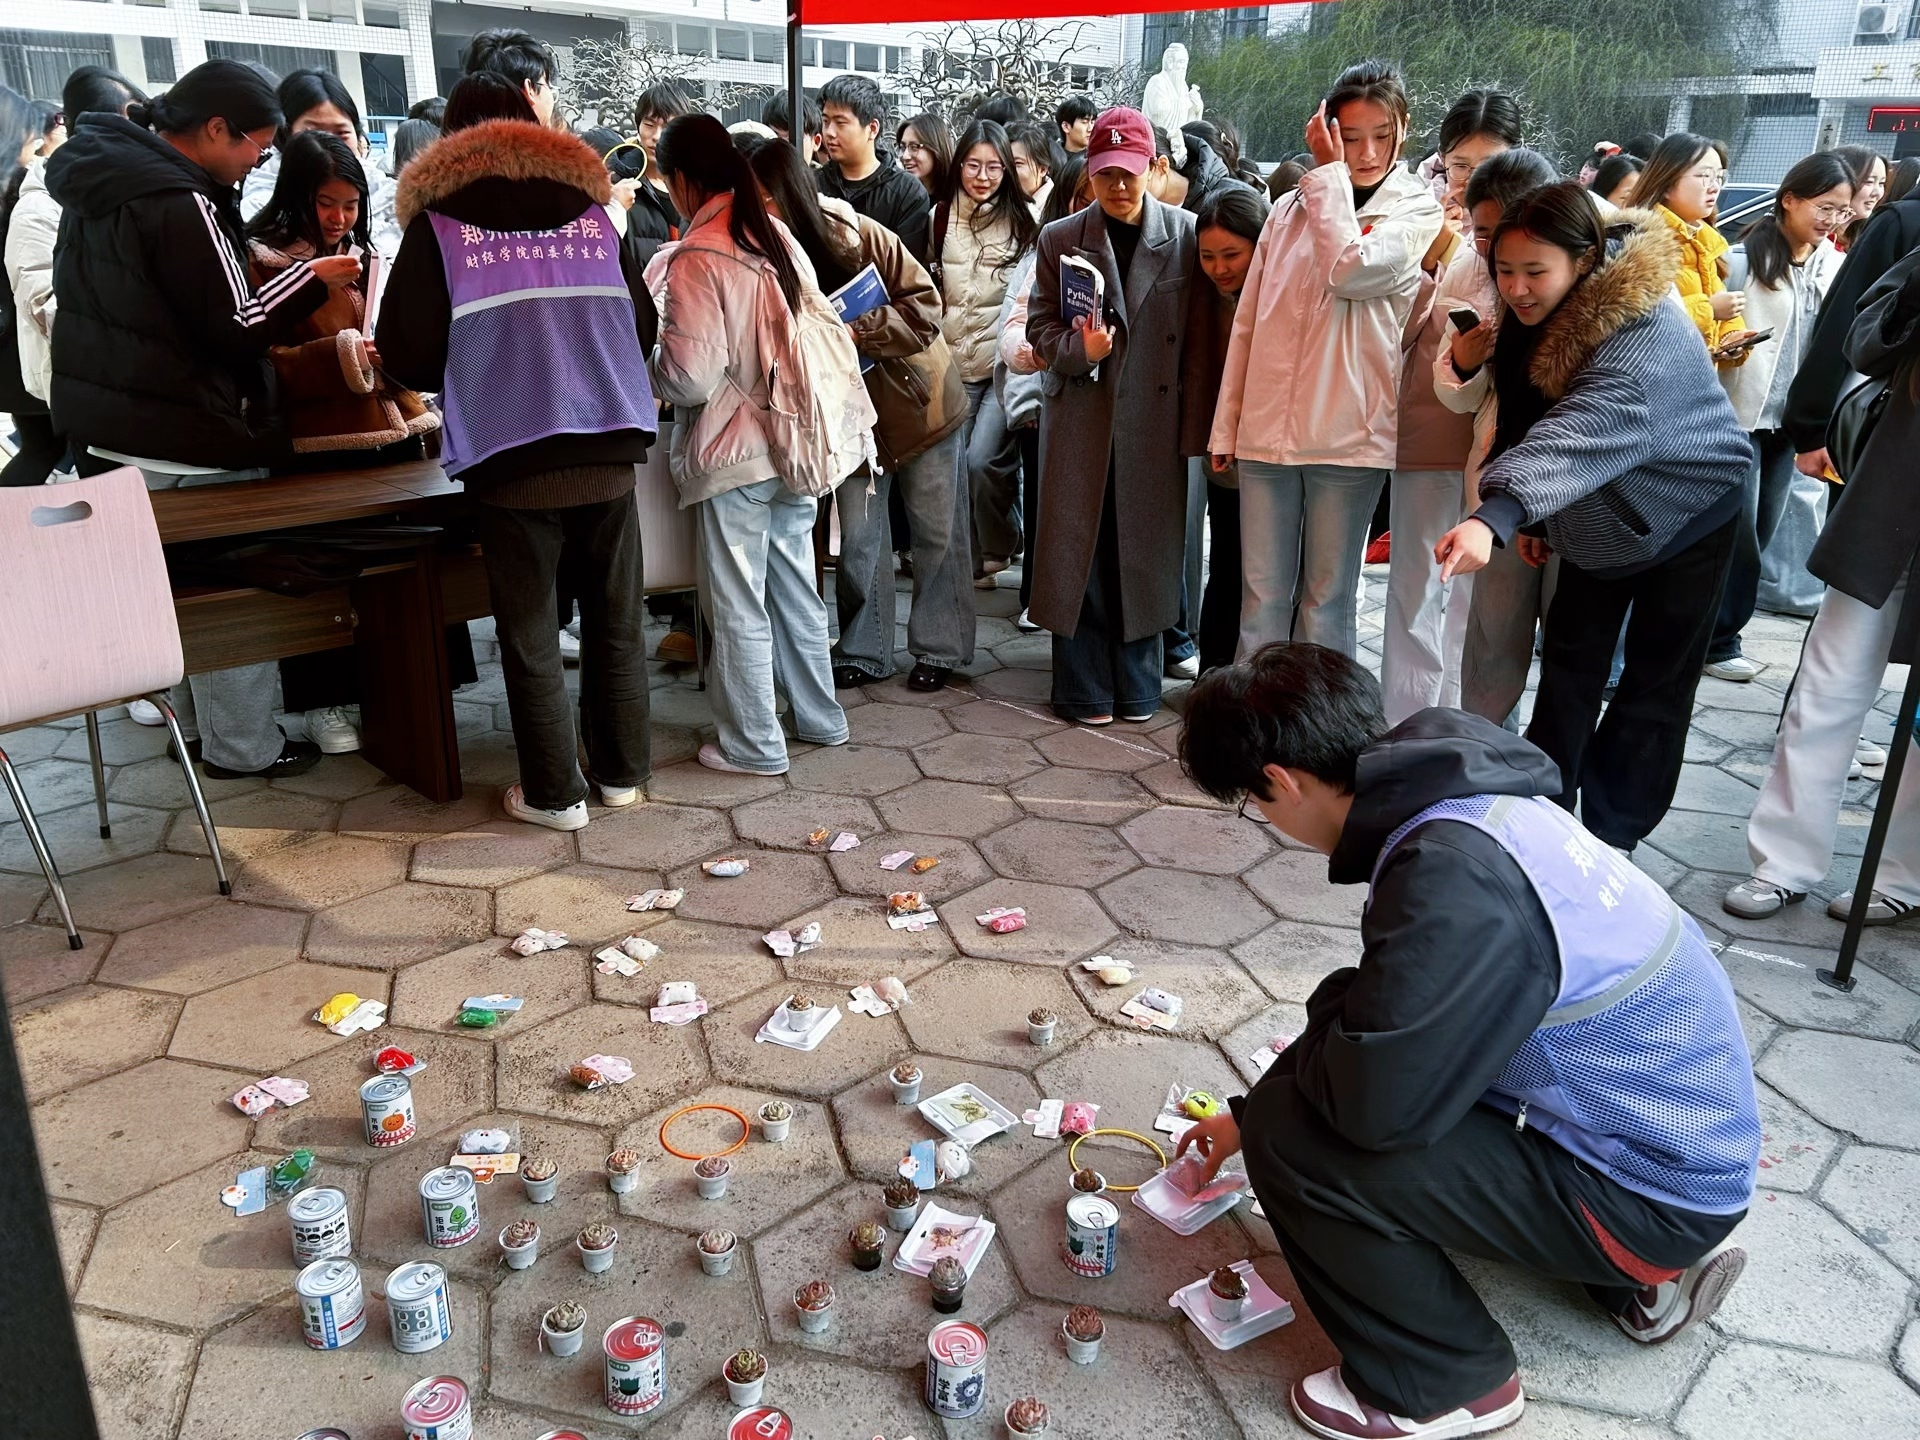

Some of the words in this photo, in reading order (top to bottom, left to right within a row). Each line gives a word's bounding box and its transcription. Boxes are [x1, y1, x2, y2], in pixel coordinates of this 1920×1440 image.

[1111, 129, 1121, 144] LA
[465, 243, 608, 269] 财经学院团委学生会
